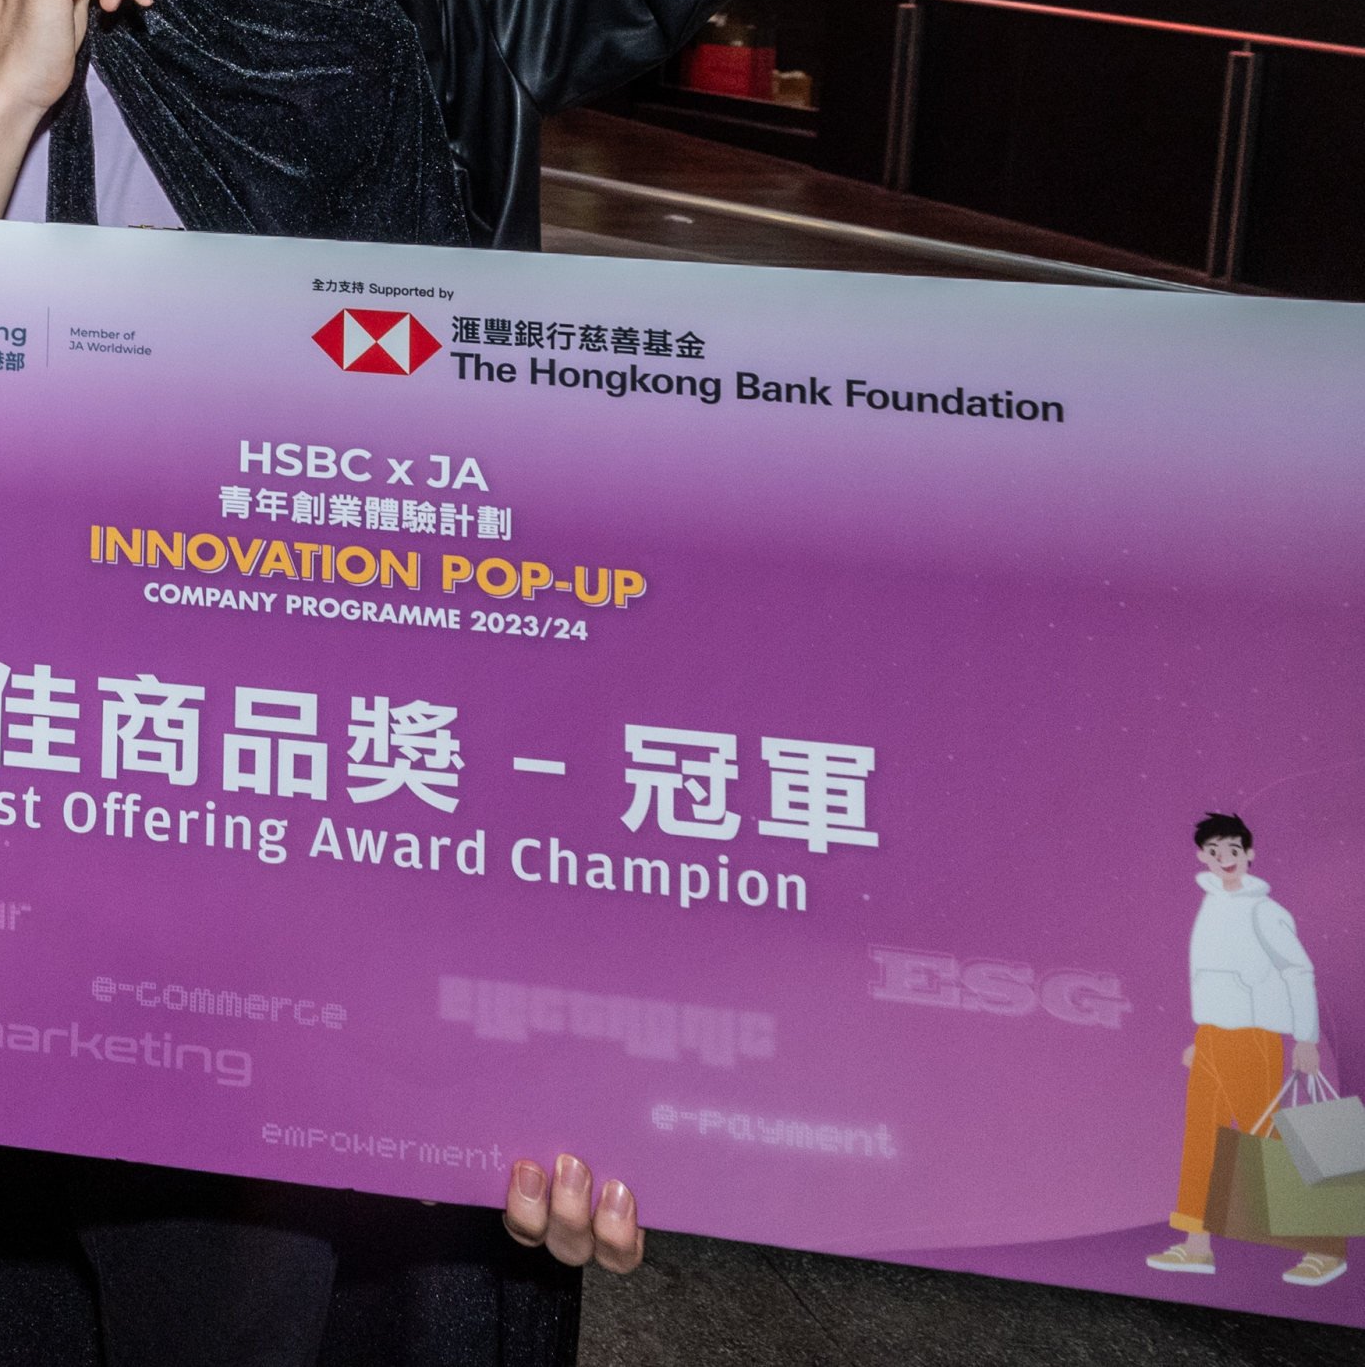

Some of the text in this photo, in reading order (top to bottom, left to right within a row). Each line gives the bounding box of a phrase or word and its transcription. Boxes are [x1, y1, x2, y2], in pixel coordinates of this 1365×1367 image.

[311, 278, 455, 302] 全力支持 Supported by
[69, 341, 152, 356] JA Worldwide
[70, 327, 136, 341] Member of
[450, 351, 1065, 423] The Hongkong Bank Foundation
[239, 439, 490, 492] HSBC x JA
[218, 485, 512, 542] 青年創業體驗計劃
[90, 524, 647, 609] INNOVATION POP-UP
[143, 582, 588, 641] COMPANY PROGRAMME 2023/24
[619, 723, 879, 854] 冠軍
[64, 790, 289, 865] Offering
[310, 819, 486, 877] Award
[511, 839, 807, 912] Champion
[92, 976, 347, 1030] e-commerce
[870, 944, 1132, 1029] ESG
